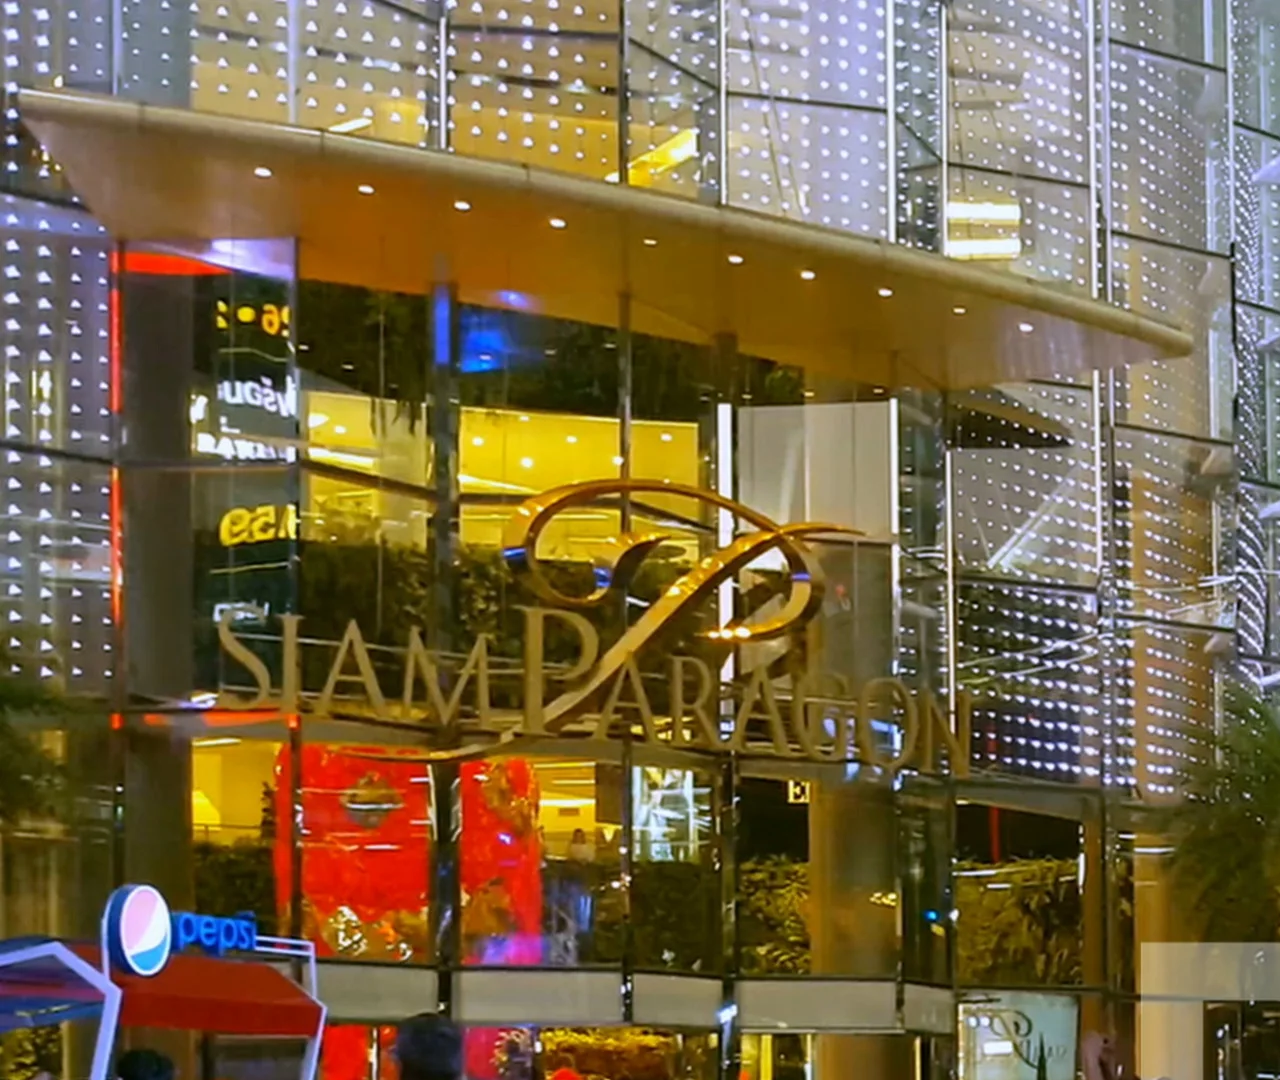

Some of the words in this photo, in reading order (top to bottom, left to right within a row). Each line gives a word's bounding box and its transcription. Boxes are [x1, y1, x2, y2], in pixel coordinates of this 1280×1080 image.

[215, 610, 490, 737] SIAM
[512, 605, 972, 778] PARAGON
[179, 912, 257, 957] pepsi
